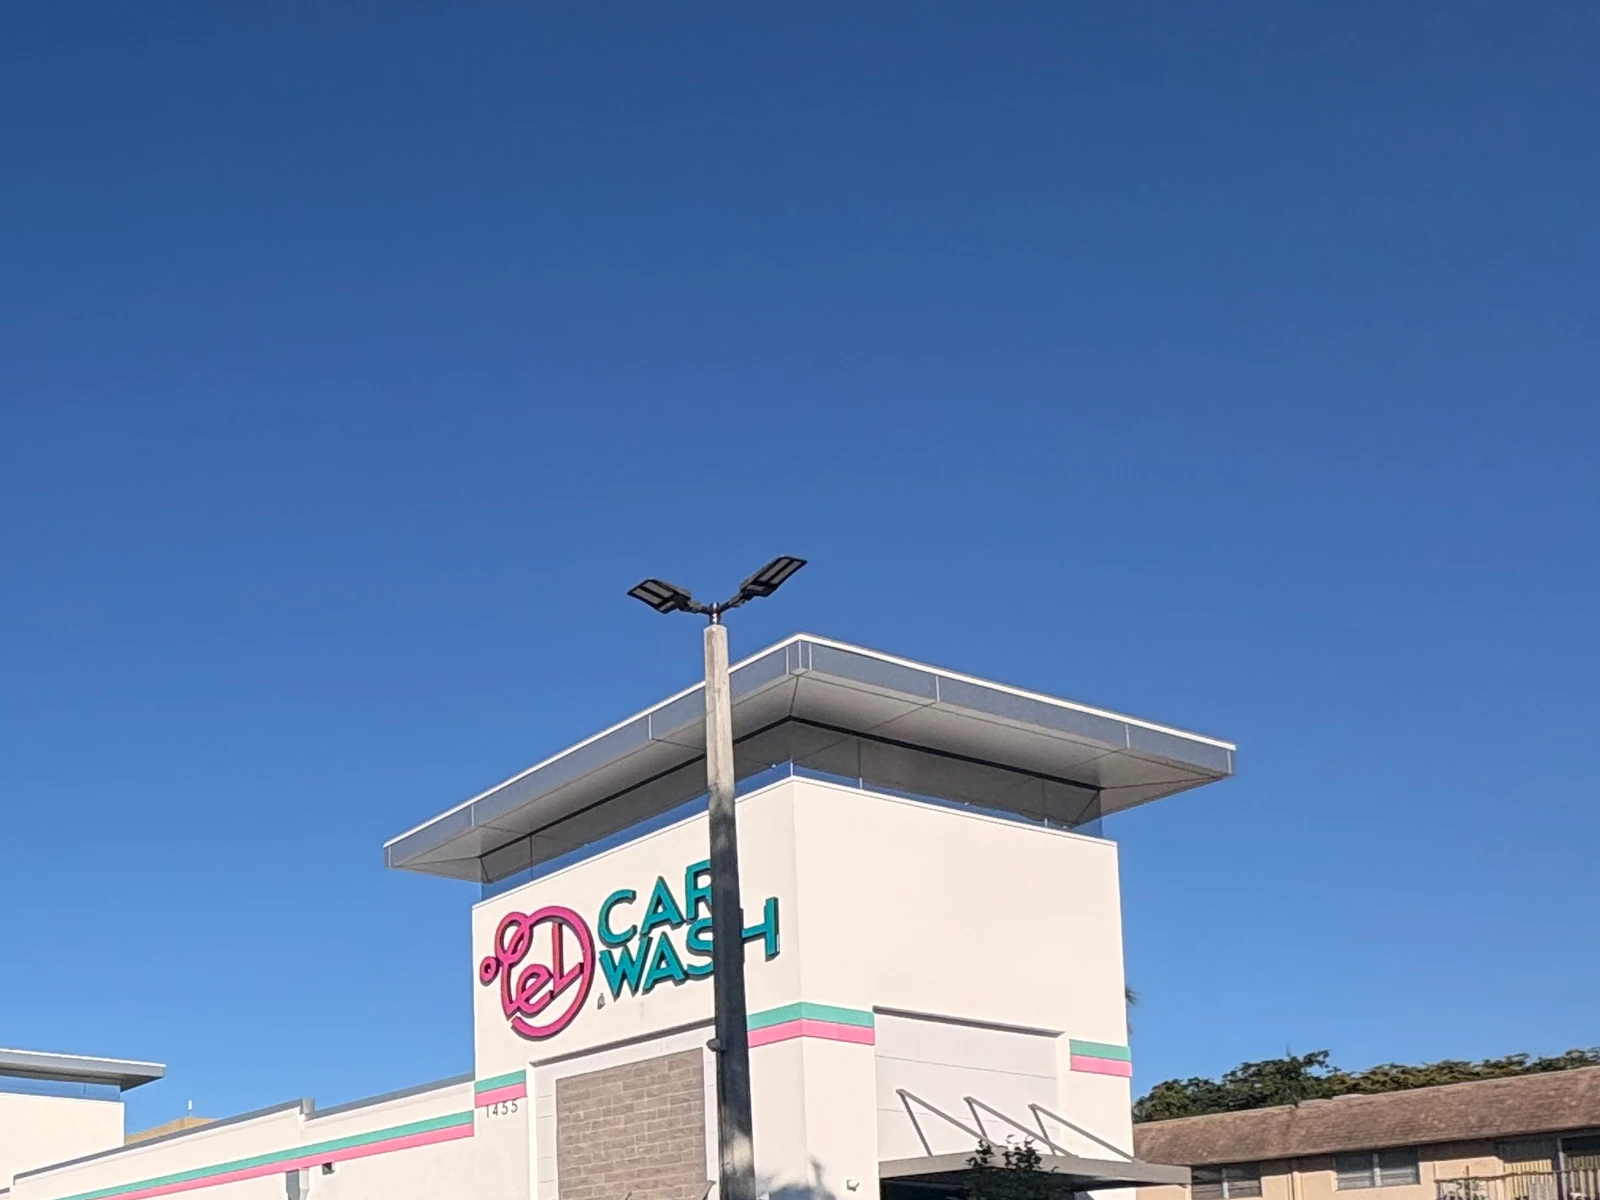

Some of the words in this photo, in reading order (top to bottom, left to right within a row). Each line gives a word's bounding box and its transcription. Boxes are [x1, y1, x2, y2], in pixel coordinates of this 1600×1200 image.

[598, 859, 713, 947] CAR
[598, 896, 780, 1003] WASH
[486, 1099, 519, 1119] 1455
